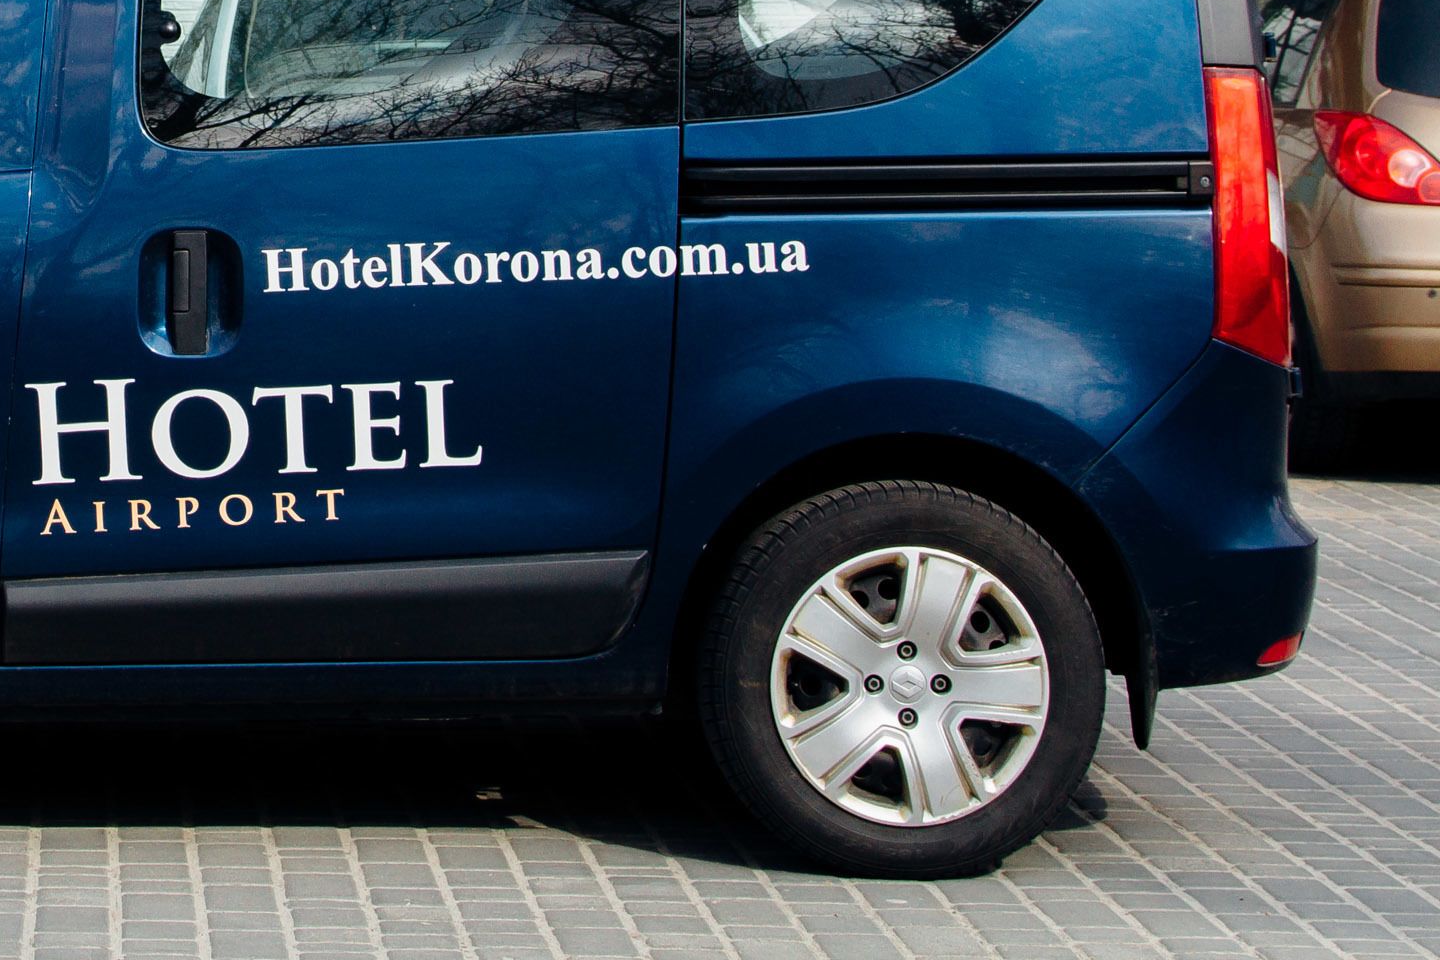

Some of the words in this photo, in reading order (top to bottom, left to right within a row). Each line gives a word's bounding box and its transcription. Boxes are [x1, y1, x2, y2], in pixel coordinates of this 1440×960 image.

[261, 240, 810, 293] HotelKorona.com.ua
[24, 378, 483, 486] HOTEL
[40, 488, 345, 536] AIRPORT
